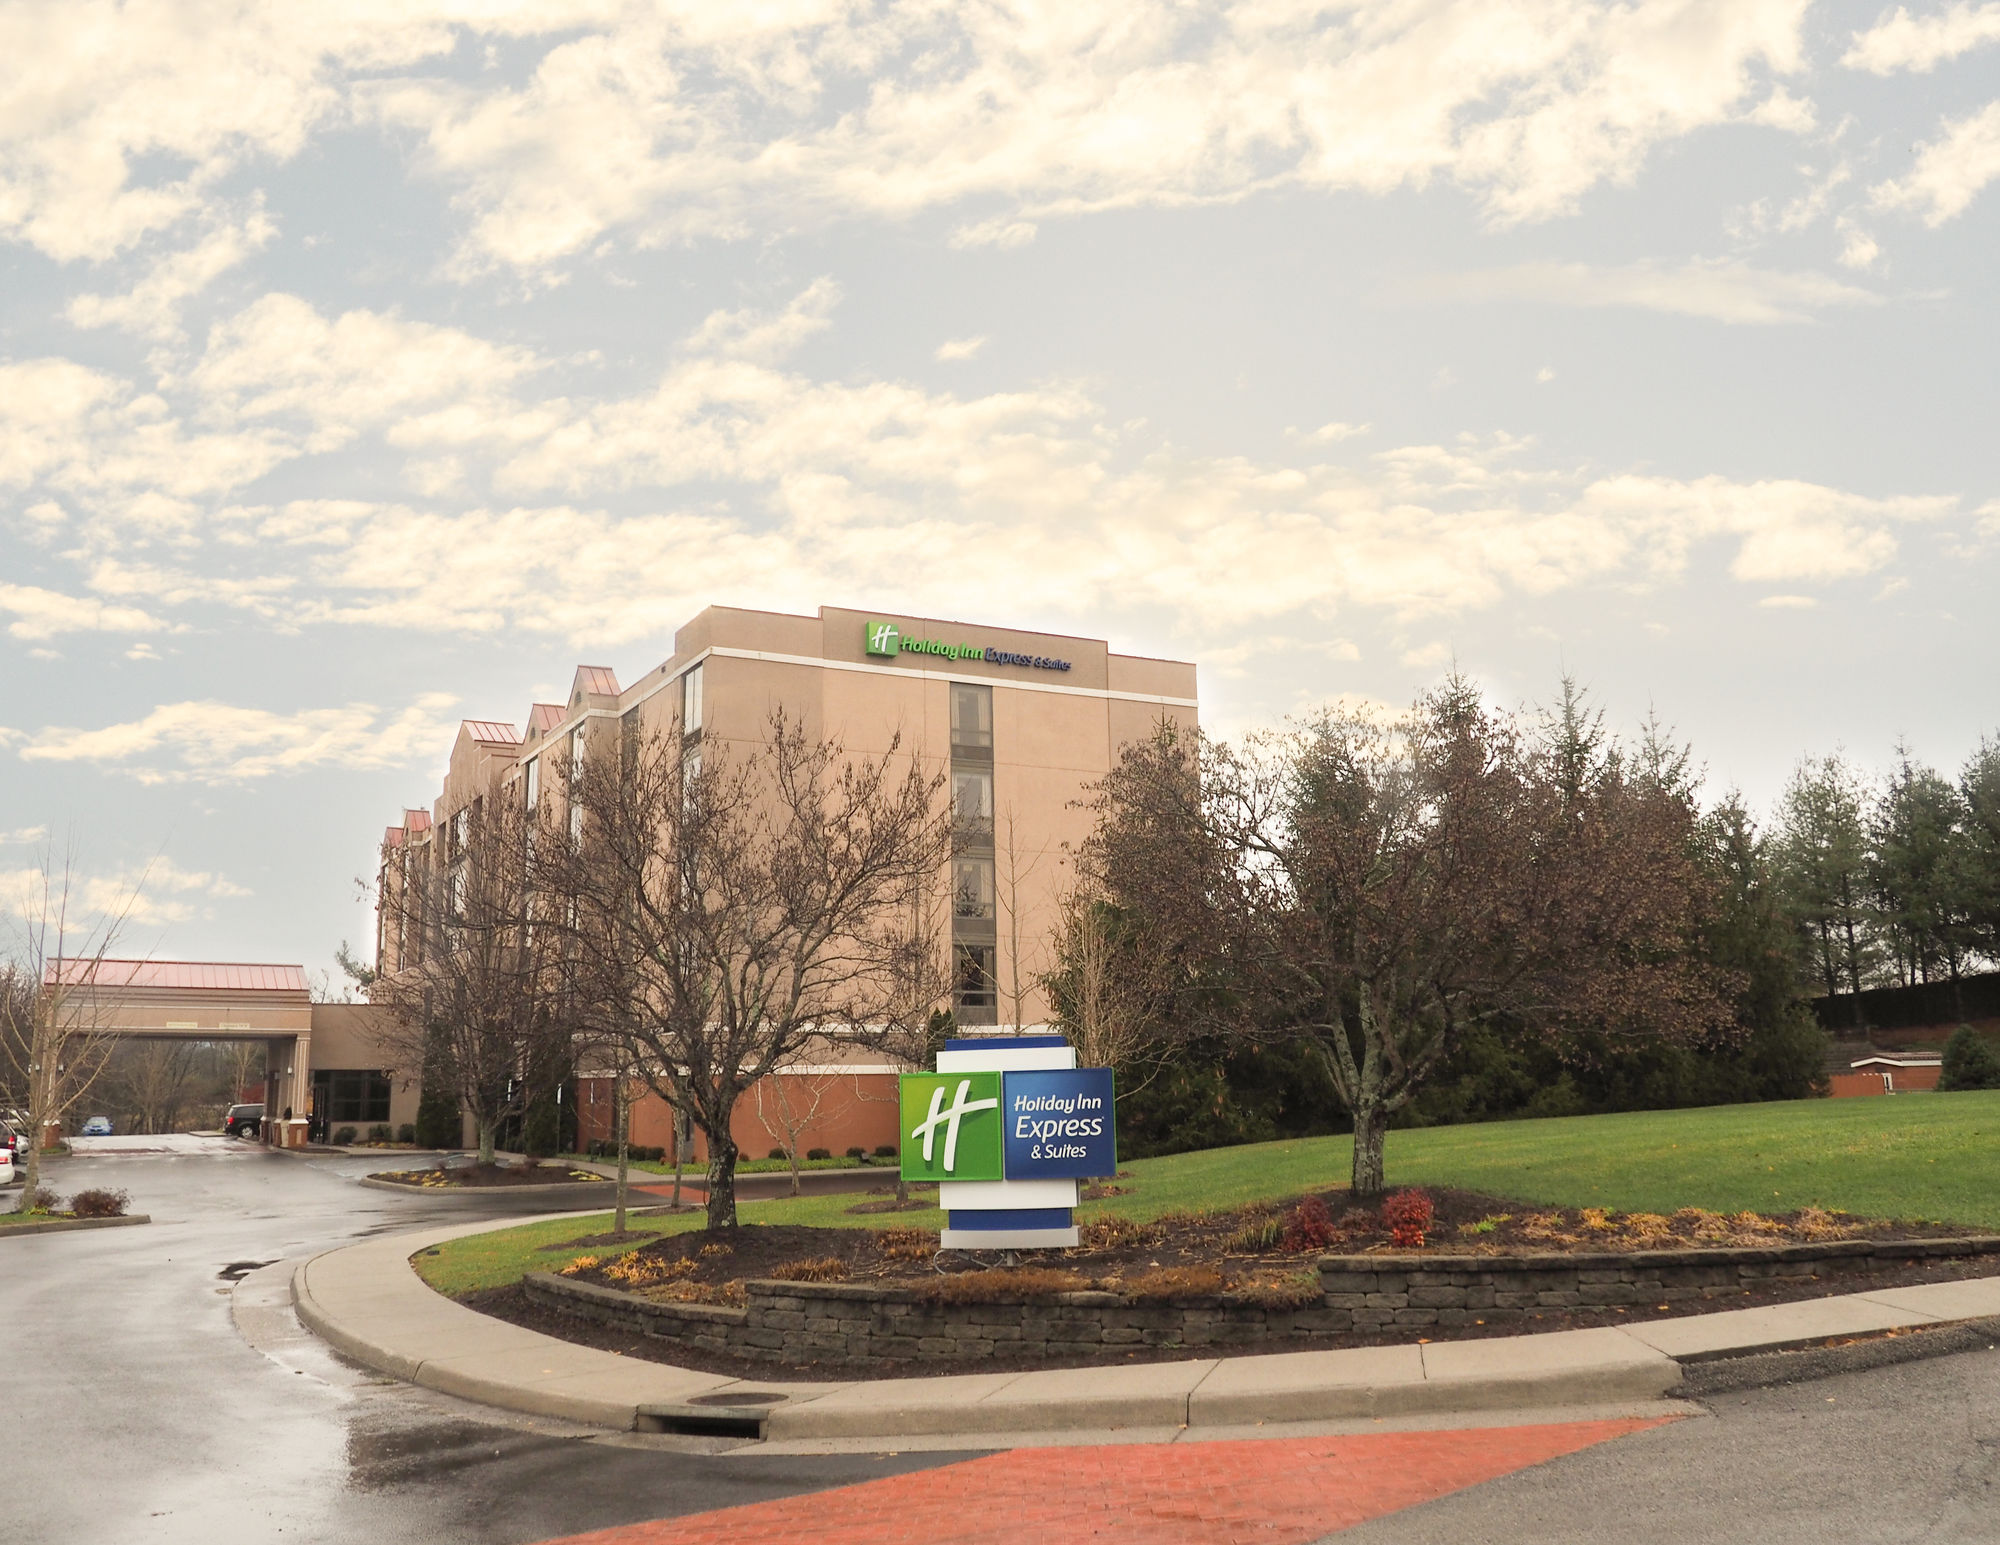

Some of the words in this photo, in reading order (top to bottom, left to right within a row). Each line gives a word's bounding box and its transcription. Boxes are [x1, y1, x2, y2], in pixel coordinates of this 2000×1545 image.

[901, 635, 958, 661] Holiday
[960, 642, 983, 660] Inn
[985, 647, 1033, 666] Express
[1034, 656, 1041, 667] &
[1043, 657, 1072, 671] Suites
[1014, 1094, 1075, 1114] Holiday
[1077, 1093, 1102, 1110] Inn
[1015, 1115, 1102, 1143] Express
[1031, 1145, 1042, 1159] &
[1044, 1144, 1087, 1159] Suites
